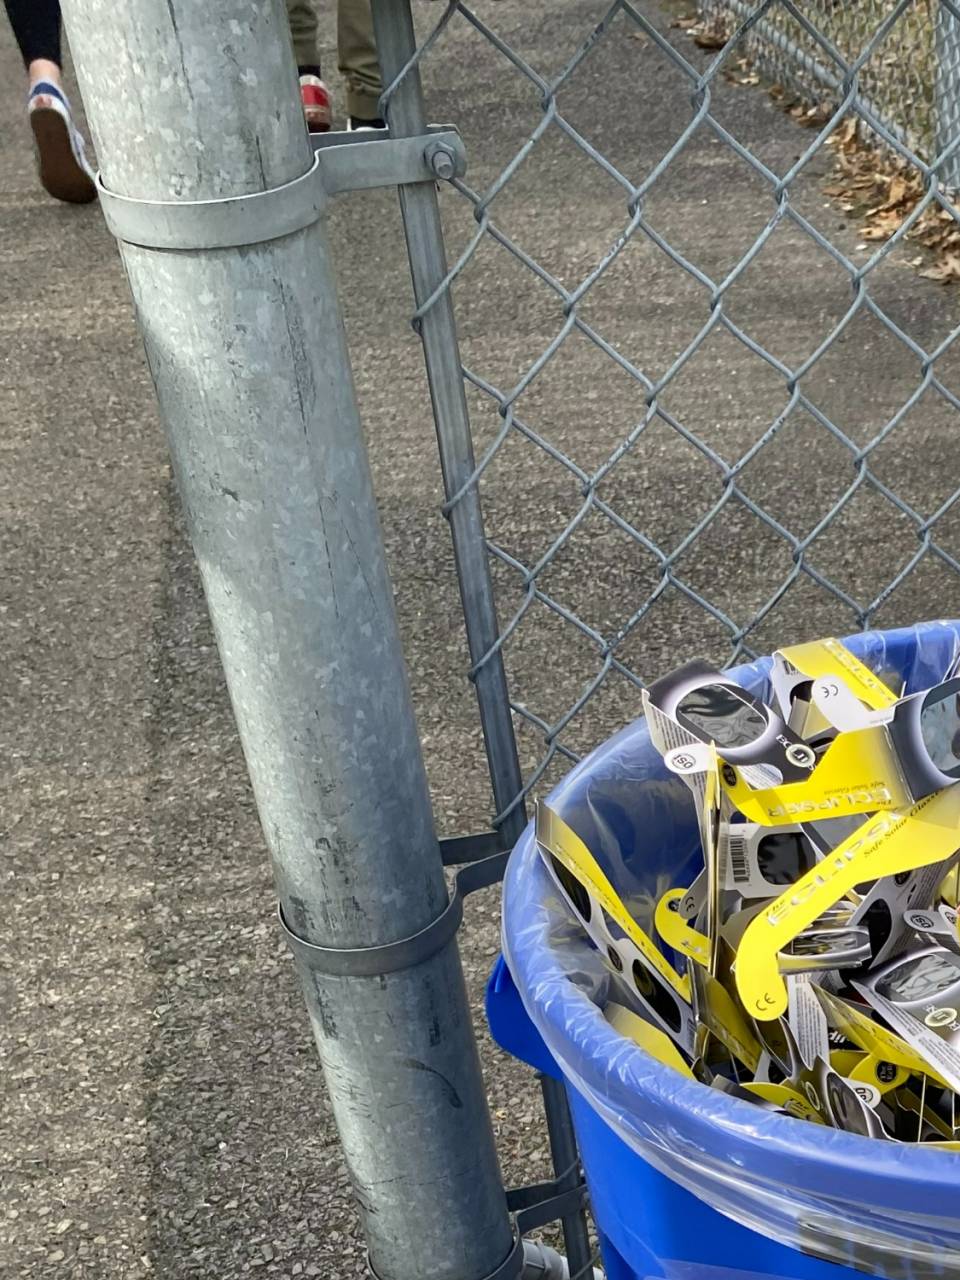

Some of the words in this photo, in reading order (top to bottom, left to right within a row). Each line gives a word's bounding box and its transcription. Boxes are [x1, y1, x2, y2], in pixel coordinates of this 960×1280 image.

[671, 754, 694, 770] ISO
[862, 837, 885, 858] Safe
[882, 815, 910, 840] Solar
[755, 993, 775, 1010] CE
